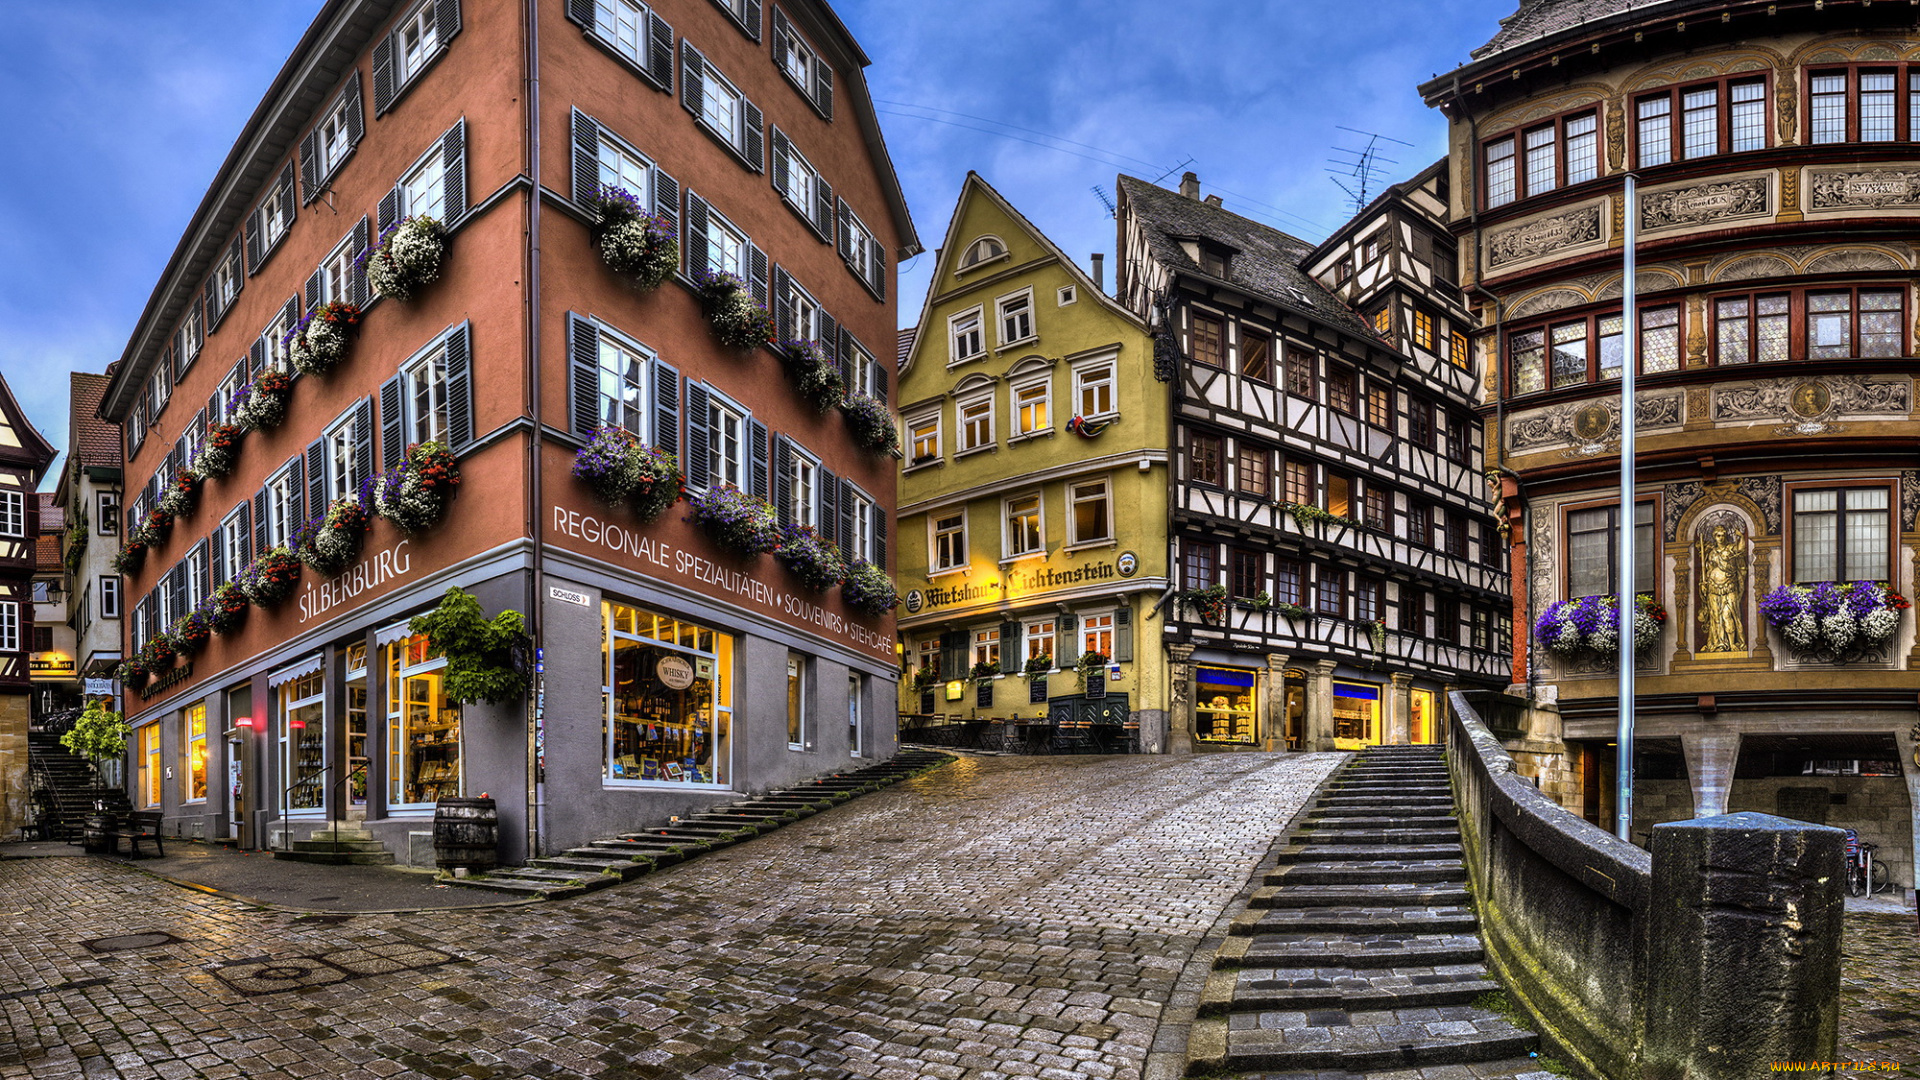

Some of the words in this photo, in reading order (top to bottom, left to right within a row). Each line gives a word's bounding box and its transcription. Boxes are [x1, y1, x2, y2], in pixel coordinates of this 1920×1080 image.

[554, 505, 670, 568] REGIONALE
[675, 549, 774, 607] SPEZIALITÄTEN
[784, 593, 842, 634] SOUVENIRS
[850, 622, 892, 656] STEHCAFÉ
[552, 588, 581, 603] SCHLOSS
[662, 666, 690, 680] WHISKY
